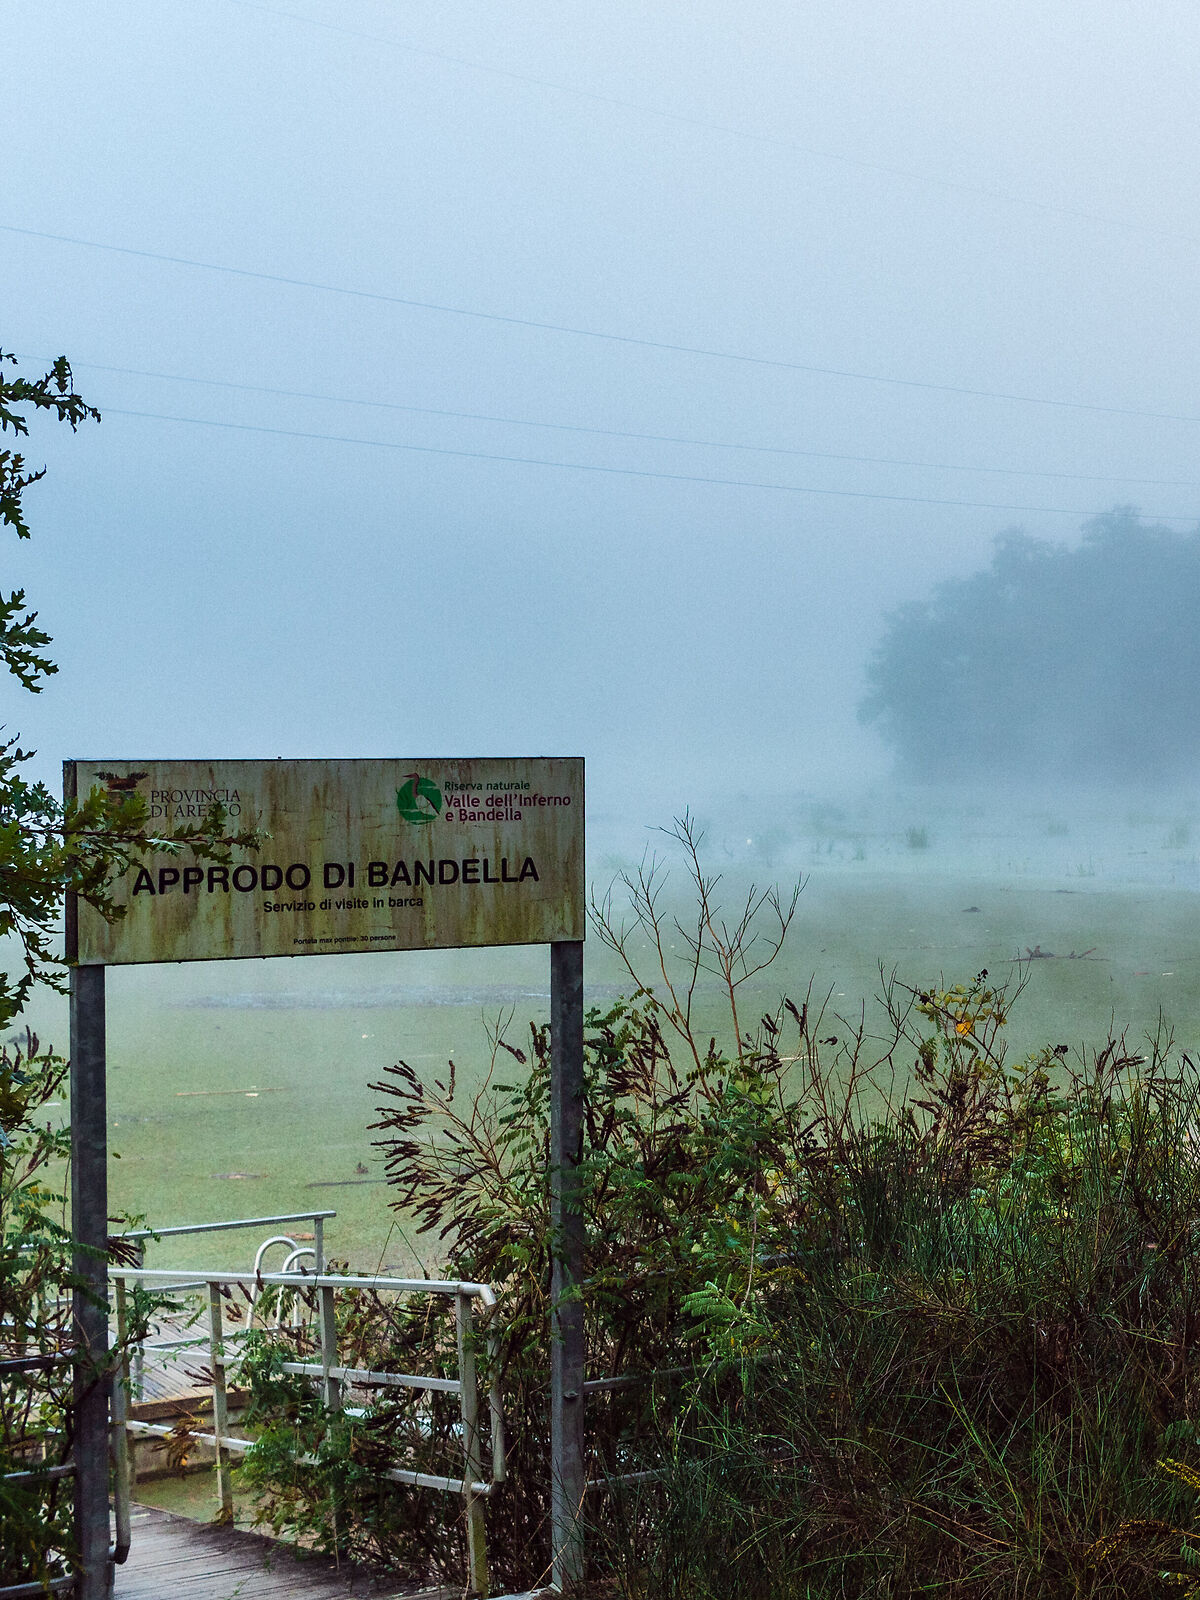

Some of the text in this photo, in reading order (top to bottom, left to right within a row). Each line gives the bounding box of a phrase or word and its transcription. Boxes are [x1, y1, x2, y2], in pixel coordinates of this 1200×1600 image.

[444, 781, 530, 791] Riserva naturale
[151, 789, 241, 803] PROVINCIA
[445, 793, 571, 808] Valle dell'Inferno
[151, 803, 241, 818] DI AREO
[445, 808, 522, 821] e Bandella
[132, 857, 540, 896] APPRODO DI BANDELLA
[263, 896, 423, 912] Servizio di visite in barca
